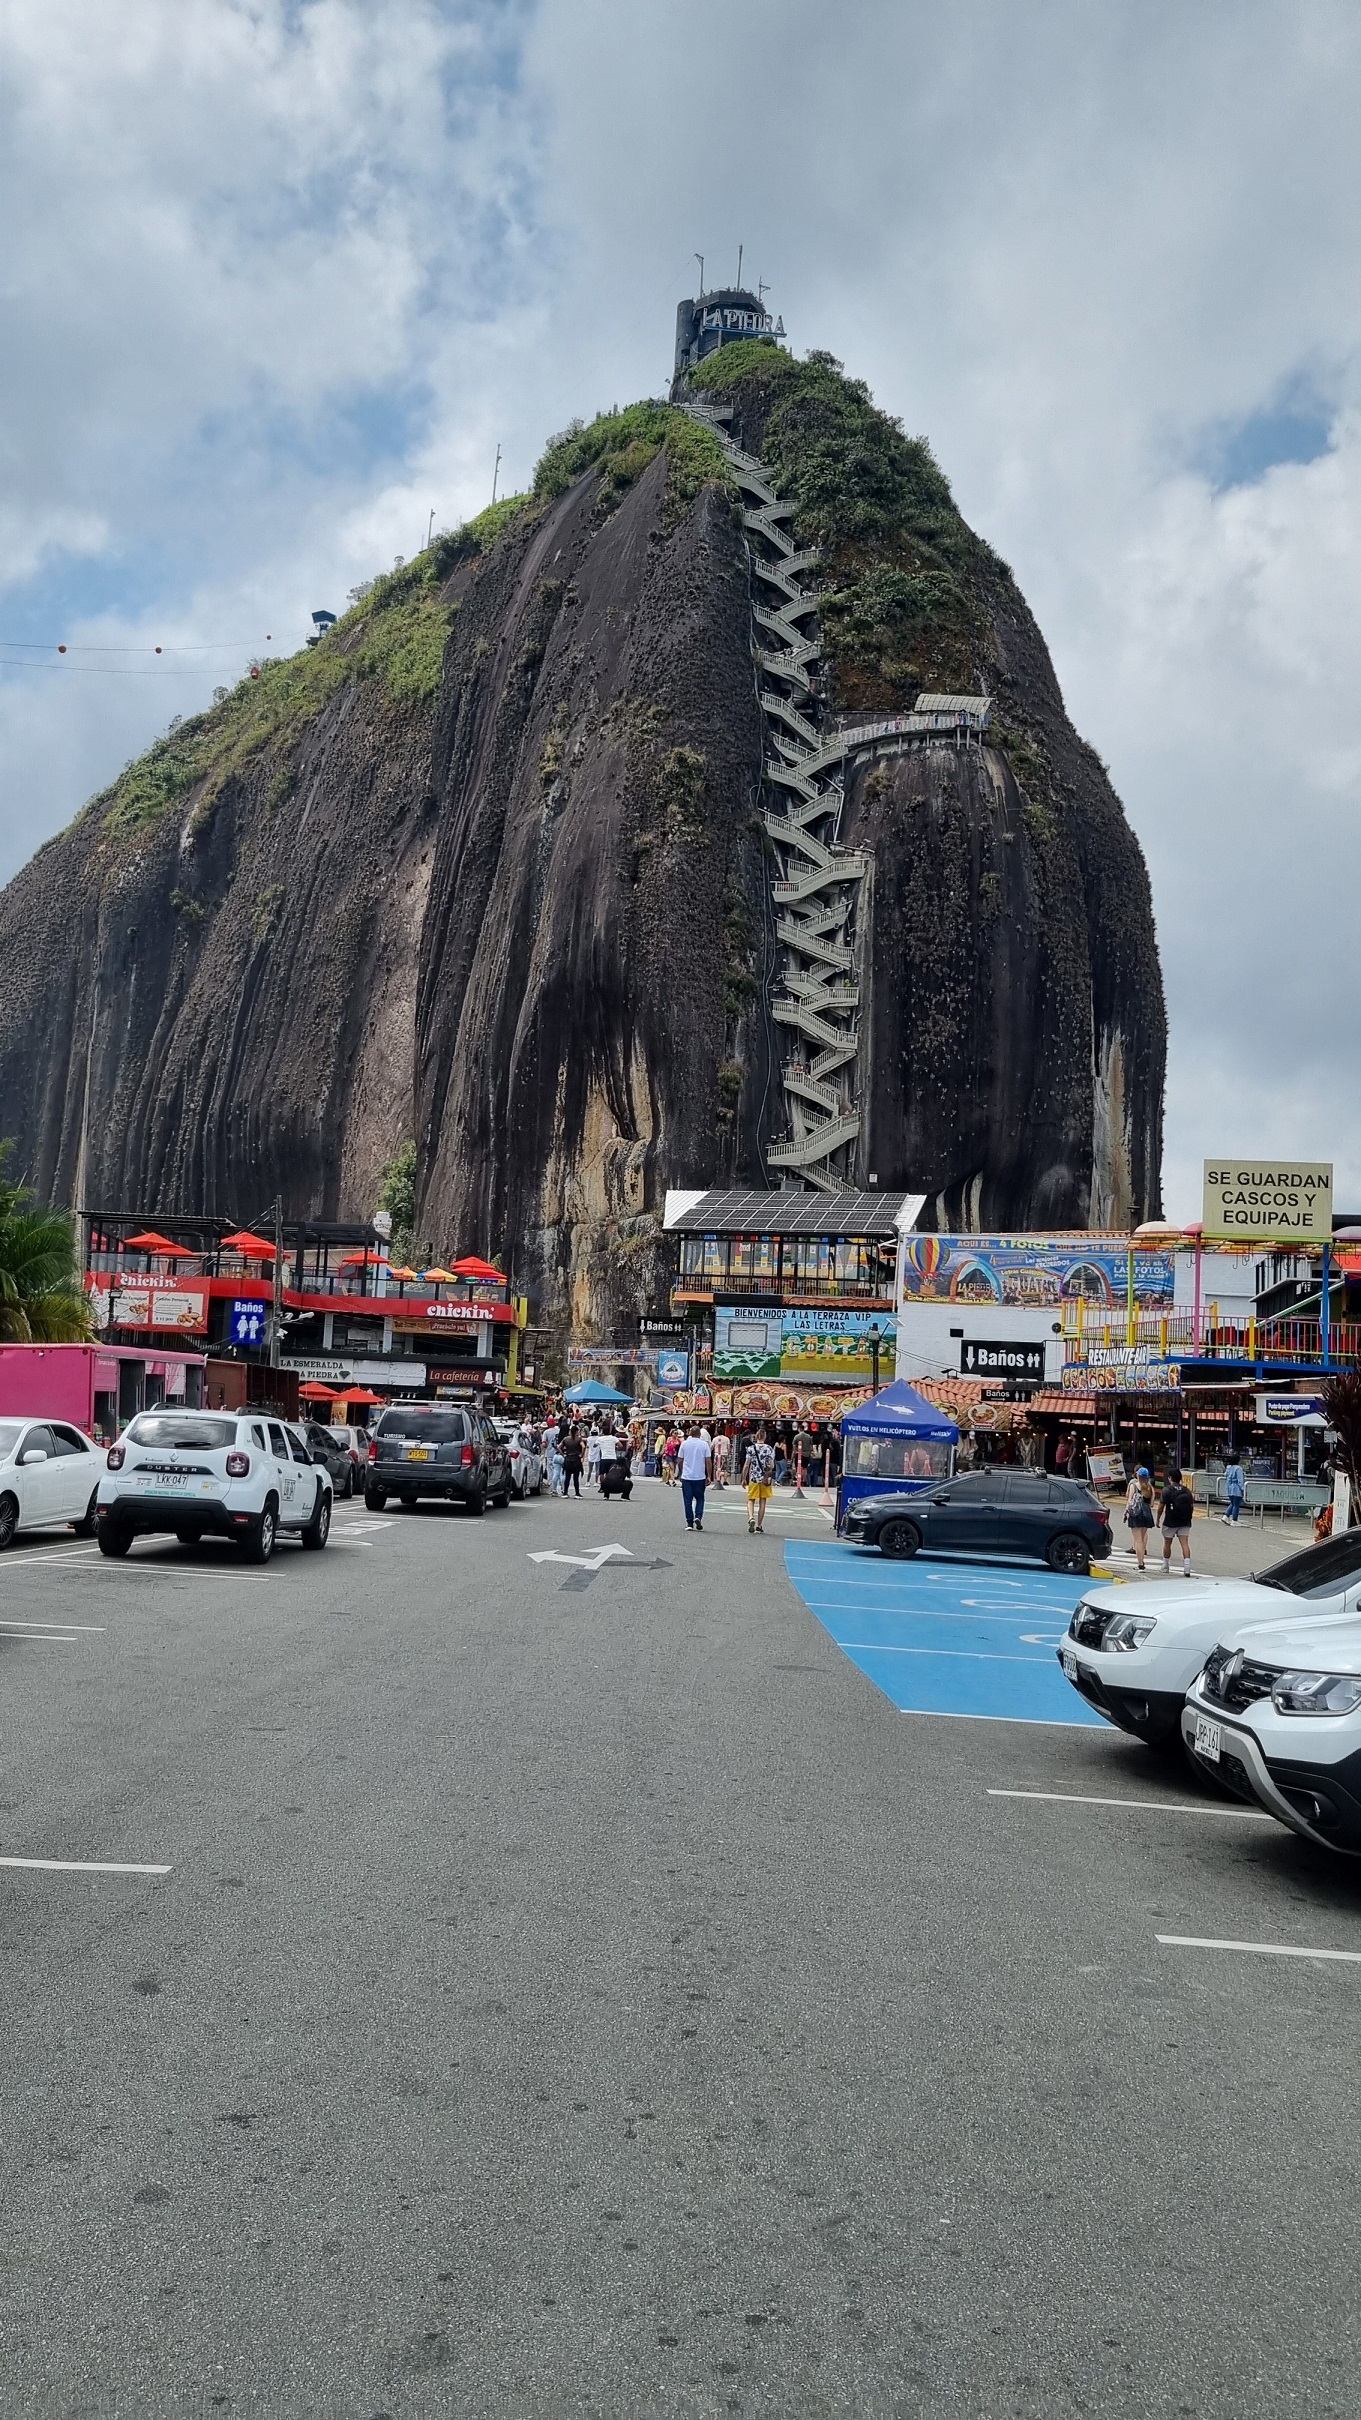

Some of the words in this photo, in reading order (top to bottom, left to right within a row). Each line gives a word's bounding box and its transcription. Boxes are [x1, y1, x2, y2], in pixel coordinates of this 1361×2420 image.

[703, 307, 723, 327] LA
[724, 309, 786, 334] PIEDRA
[1207, 1171, 1231, 1185] SE
[1237, 1172, 1329, 1189] GUARDAN
[1221, 1191, 1299, 1207] CASCOS
[1304, 1193, 1317, 1207] Y
[1223, 1210, 1314, 1227] EQUIPAJE
[1000, 1240, 1006, 1248] 4
[1010, 1240, 1049, 1250] FOTOS
[234, 1301, 264, 1313] Baños
[734, 1308, 787, 1319] BIENVENIDOS
[791, 1309, 797, 1319] A
[799, 1310, 809, 1320] LA
[813, 1311, 850, 1321] TERRAZA
[855, 1313, 872, 1322] VIP
[646, 1320, 673, 1332] Baños
[794, 1320, 812, 1330] LAS
[814, 1321, 845, 1331] LETRAS
[977, 1348, 1025, 1367] Baños
[293, 1360, 344, 1369] ESMERALDA
[430, 1370, 440, 1380] La
[442, 1370, 480, 1382] cafetería
[985, 1389, 1010, 1398] Baños
[847, 1424, 870, 1432] VUELOS
[879, 1427, 917, 1435] HELICÓPTERO
